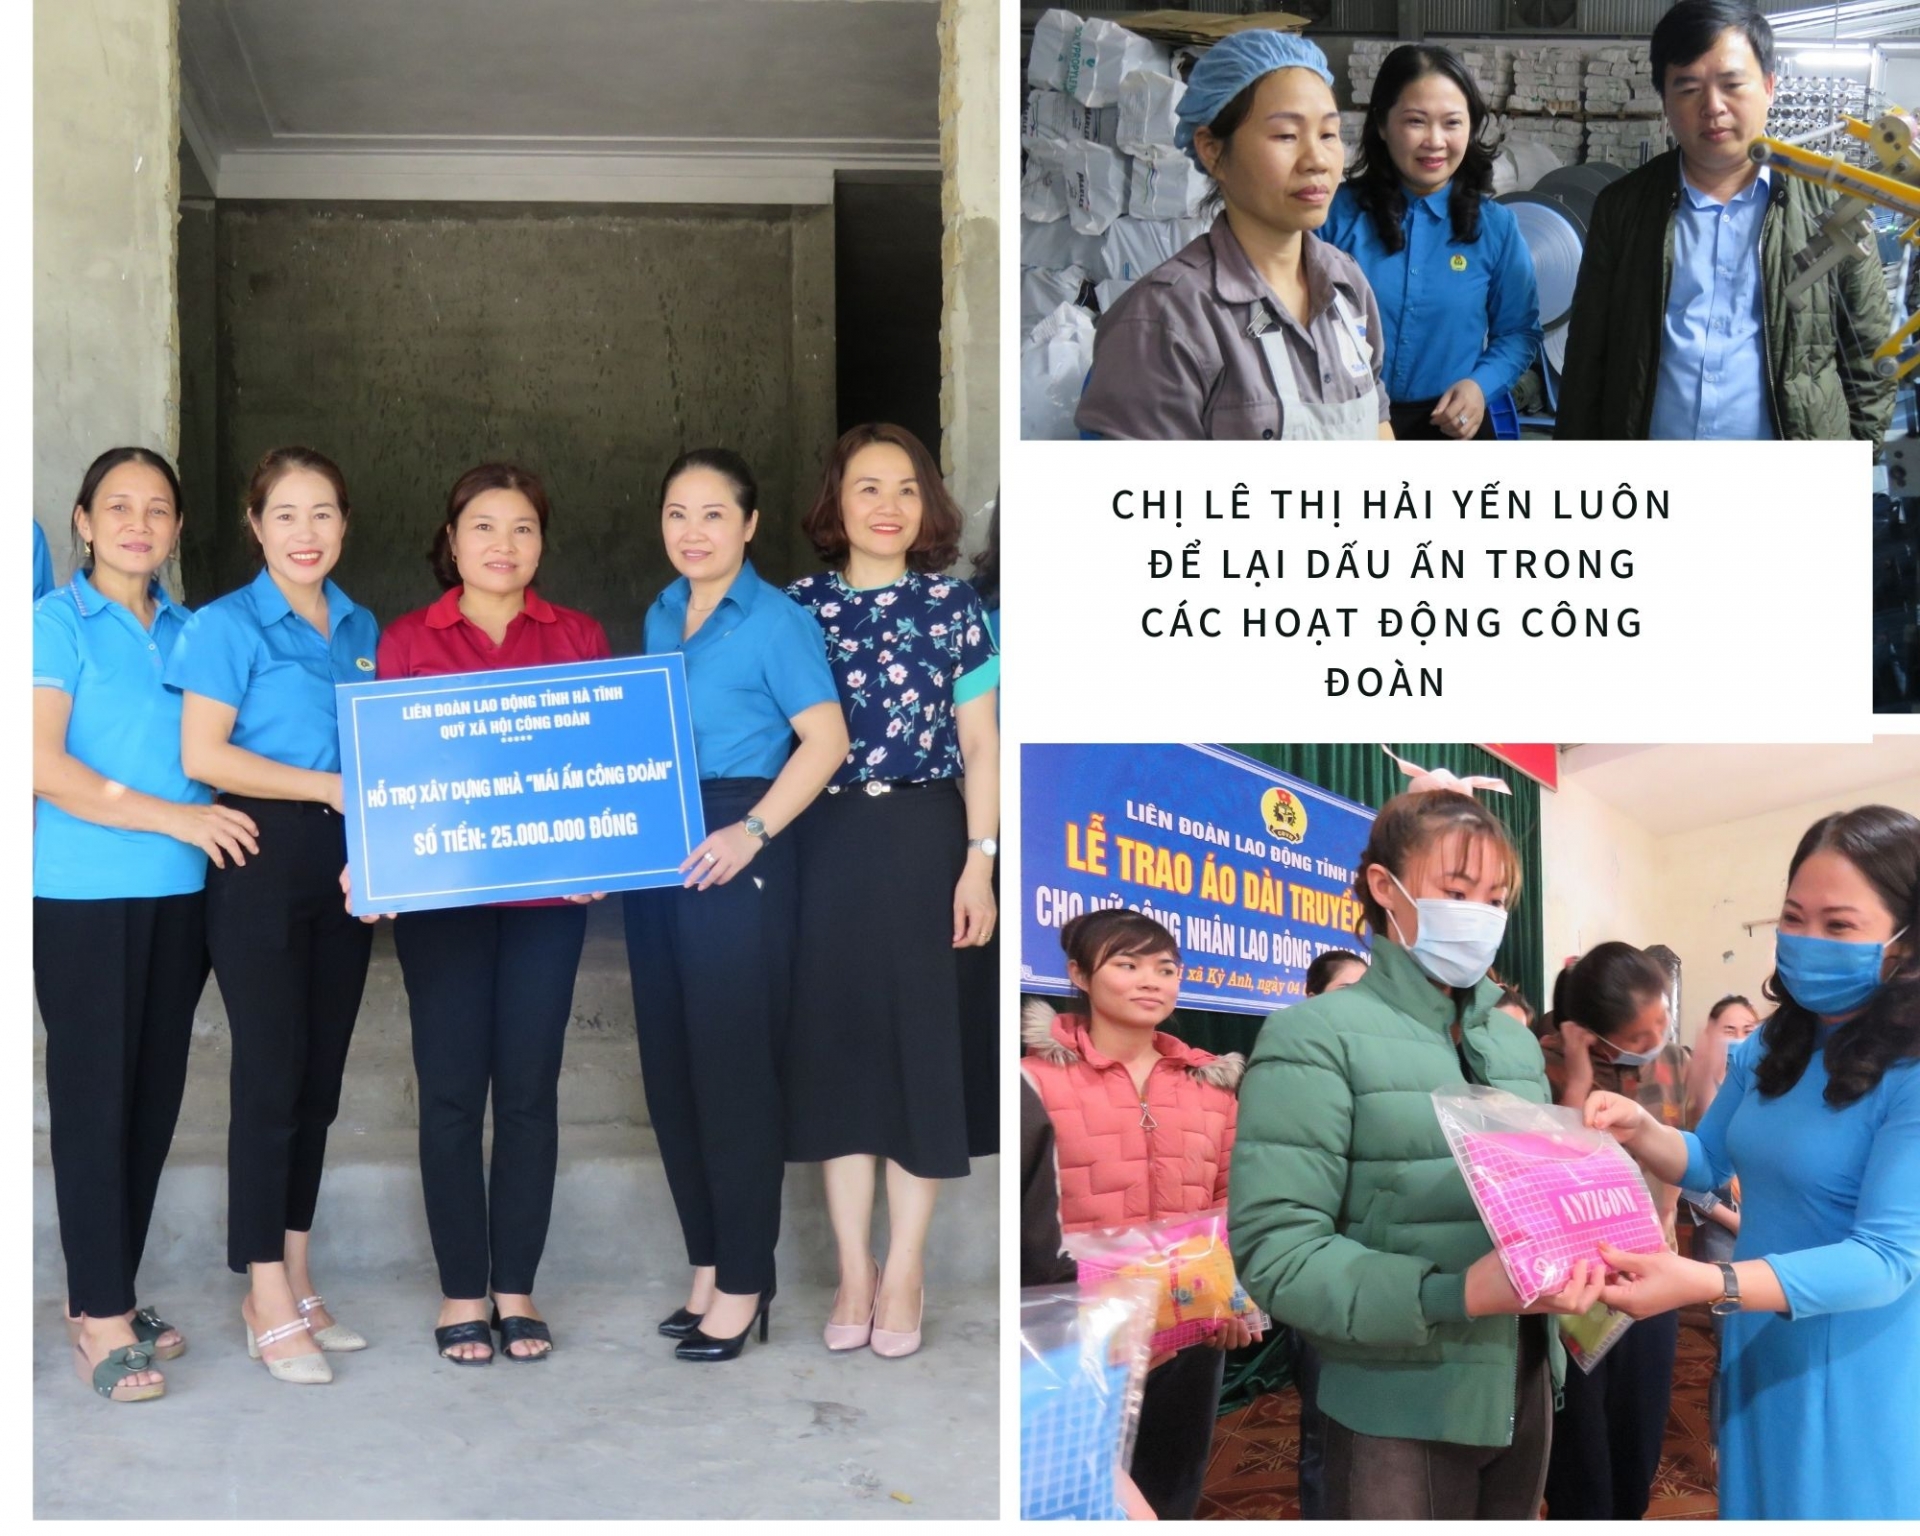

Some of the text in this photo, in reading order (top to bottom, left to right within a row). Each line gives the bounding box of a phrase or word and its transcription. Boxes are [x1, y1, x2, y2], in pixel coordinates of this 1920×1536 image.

[401, 685, 624, 720] LIÊN ĐOÀN LAO ĐỘNG TỈNH HÀ TĨNH
[440, 709, 591, 740] QUỸ XÃ HỘI CÔNG ĐOÀN
[367, 779, 388, 808] HỖ
[389, 785, 418, 810] TRỢ
[419, 778, 449, 803] XÂY
[450, 777, 492, 805] DỰNG
[492, 770, 524, 796] NHÀ
[562, 762, 585, 790] ẤM
[586, 762, 626, 787] CÔNG
[413, 807, 639, 856] SỐ TIỀN: 25.000.000 ĐỒNG
[1126, 799, 1173, 831] LIÊN
[1178, 817, 1230, 848] ĐOÀN
[1235, 834, 1266, 858] LAO
[1270, 846, 1312, 873] ĐỘNG
[1315, 857, 1347, 883] TỈNH
[1066, 811, 1108, 876] LỄ
[1114, 836, 1194, 895] TRAO
[1200, 852, 1237, 906] ÁO
[1243, 867, 1283, 917] DÀI
[1186, 914, 1235, 957] NHÂN
[1239, 926, 1269, 963] LAO
[1272, 929, 1312, 974] ĐỘNG
[1186, 965, 1203, 983] xã
[1205, 967, 1226, 989] Kỳ
[1226, 971, 1254, 990] Anh,
[1256, 976, 1285, 997] ngày
[1286, 981, 1300, 996] 04
